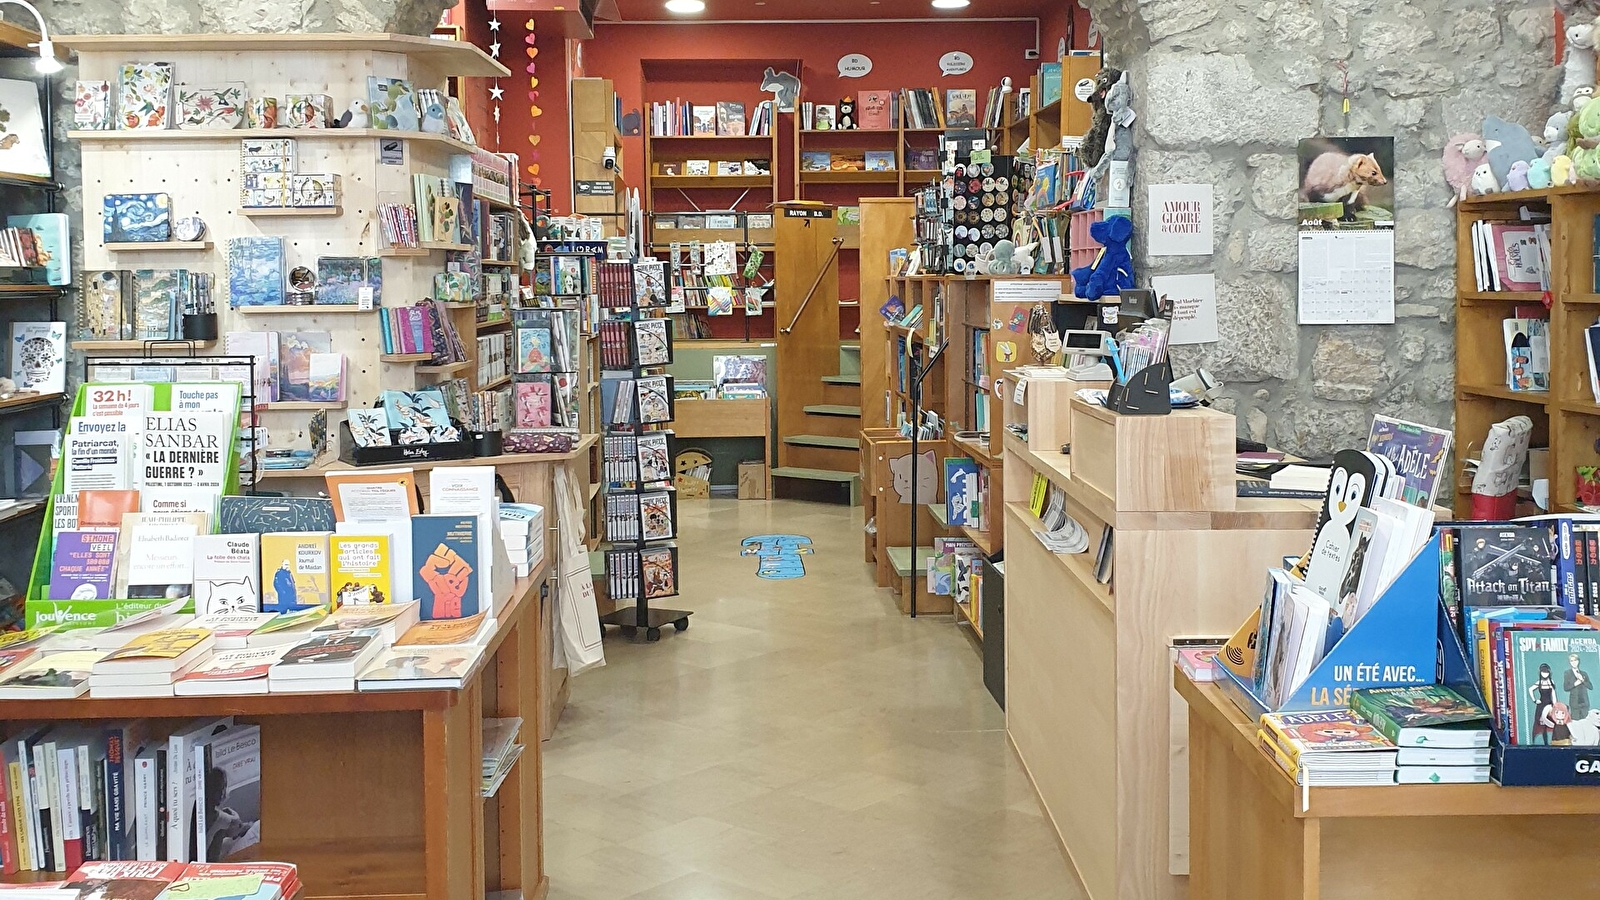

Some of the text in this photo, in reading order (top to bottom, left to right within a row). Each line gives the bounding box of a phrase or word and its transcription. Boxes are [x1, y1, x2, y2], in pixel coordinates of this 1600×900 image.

[1162, 201, 1201, 212] AMOUR
[1162, 212, 1201, 224] GLOIRE
[1301, 218, 1323, 226] Août
[179, 390, 218, 401] Touche pas
[179, 400, 184, 408] à
[78, 421, 126, 434] Envoyez la
[146, 416, 197, 432] ELIAS
[72, 440, 120, 448] Patriarcat,
[145, 434, 219, 448] SANBAR
[154, 450, 166, 464] LA
[168, 449, 219, 464] DERNIÈRE
[146, 466, 185, 478] GUERRE
[188, 466, 195, 478] ?
[153, 500, 186, 508] Comme si
[54, 518, 65, 528] LES
[67, 518, 78, 528] BO
[82, 534, 114, 542] SIMONE
[92, 544, 112, 552] VEIL
[354, 542, 378, 550] grands
[1326, 540, 1340, 552] Cahier
[1466, 577, 1550, 594] Attack on Titan
[116, 602, 152, 610] L'éditeur
[1571, 638, 1598, 646] AGENDA
[1334, 662, 1425, 682] UN ÉTÉ AVEC...
[1310, 686, 1357, 706] LA SÉ
[236, 738, 256, 750] Besco
[114, 822, 120, 831] MA
